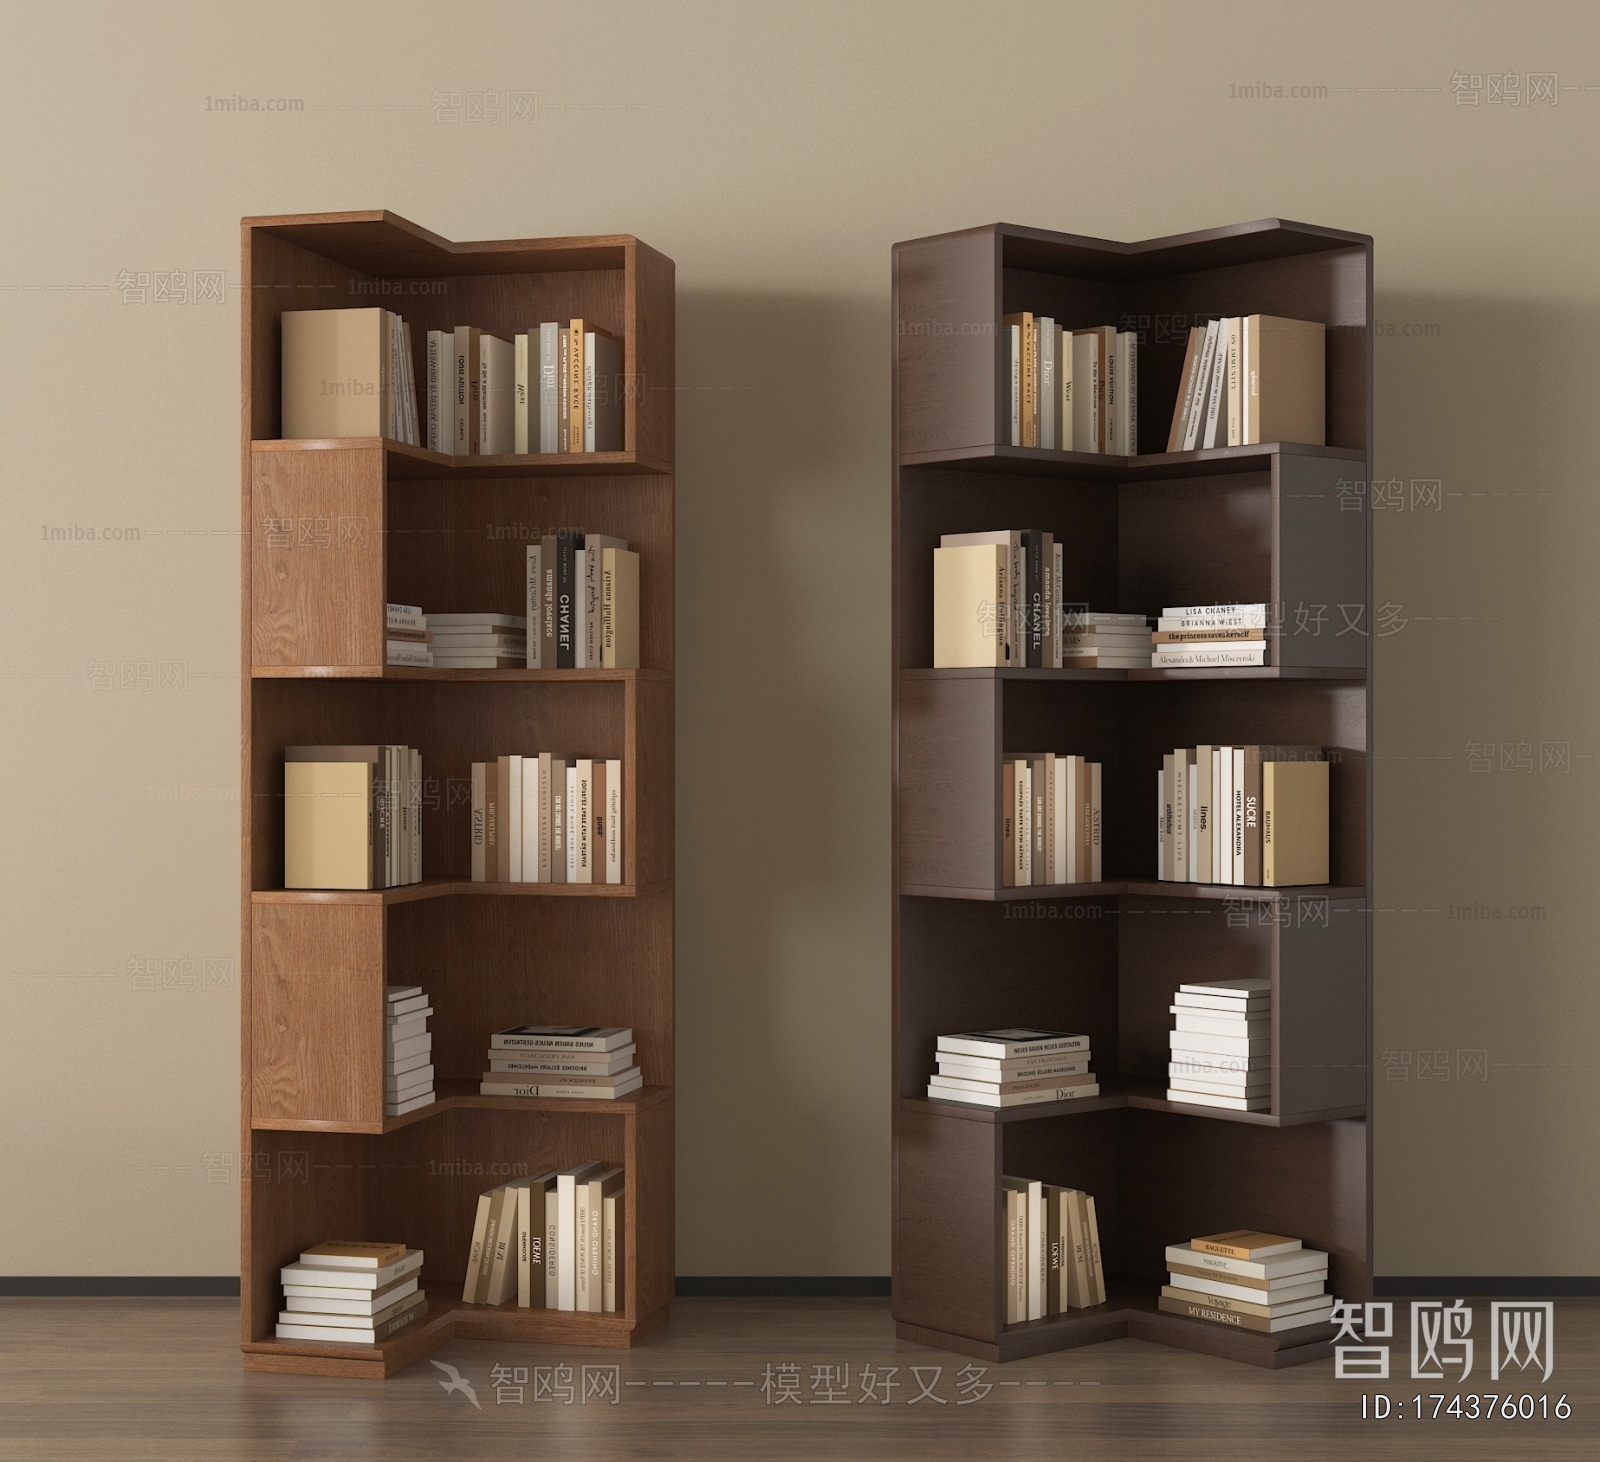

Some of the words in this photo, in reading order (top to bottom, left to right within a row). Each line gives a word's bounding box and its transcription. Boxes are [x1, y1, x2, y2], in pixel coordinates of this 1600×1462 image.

[1230, 334, 1236, 345] ON
[1043, 360, 1053, 386] Dior
[1044, 567, 1052, 600] amanda
[1185, 608, 1202, 616] LISA
[1205, 606, 1237, 614] CHANEY
[1033, 592, 1041, 650] CHANEL
[1168, 632, 1180, 640] the
[1180, 632, 1208, 641] princess
[1200, 806, 1209, 833] lines.
[1246, 796, 1256, 828] SUCRE
[1014, 1046, 1028, 1054] NEUES
[1058, 1041, 1081, 1049] GESTALTEN
[1012, 1083, 1041, 1091] PHAIDON
[1055, 1089, 1076, 1100] Dior
[1051, 1242, 1059, 1271] LOEWE
[1205, 1244, 1236, 1255] BAGUETTE
[1188, 1306, 1201, 1316] MY
[1201, 1309, 1242, 1325] RESIDENCE
